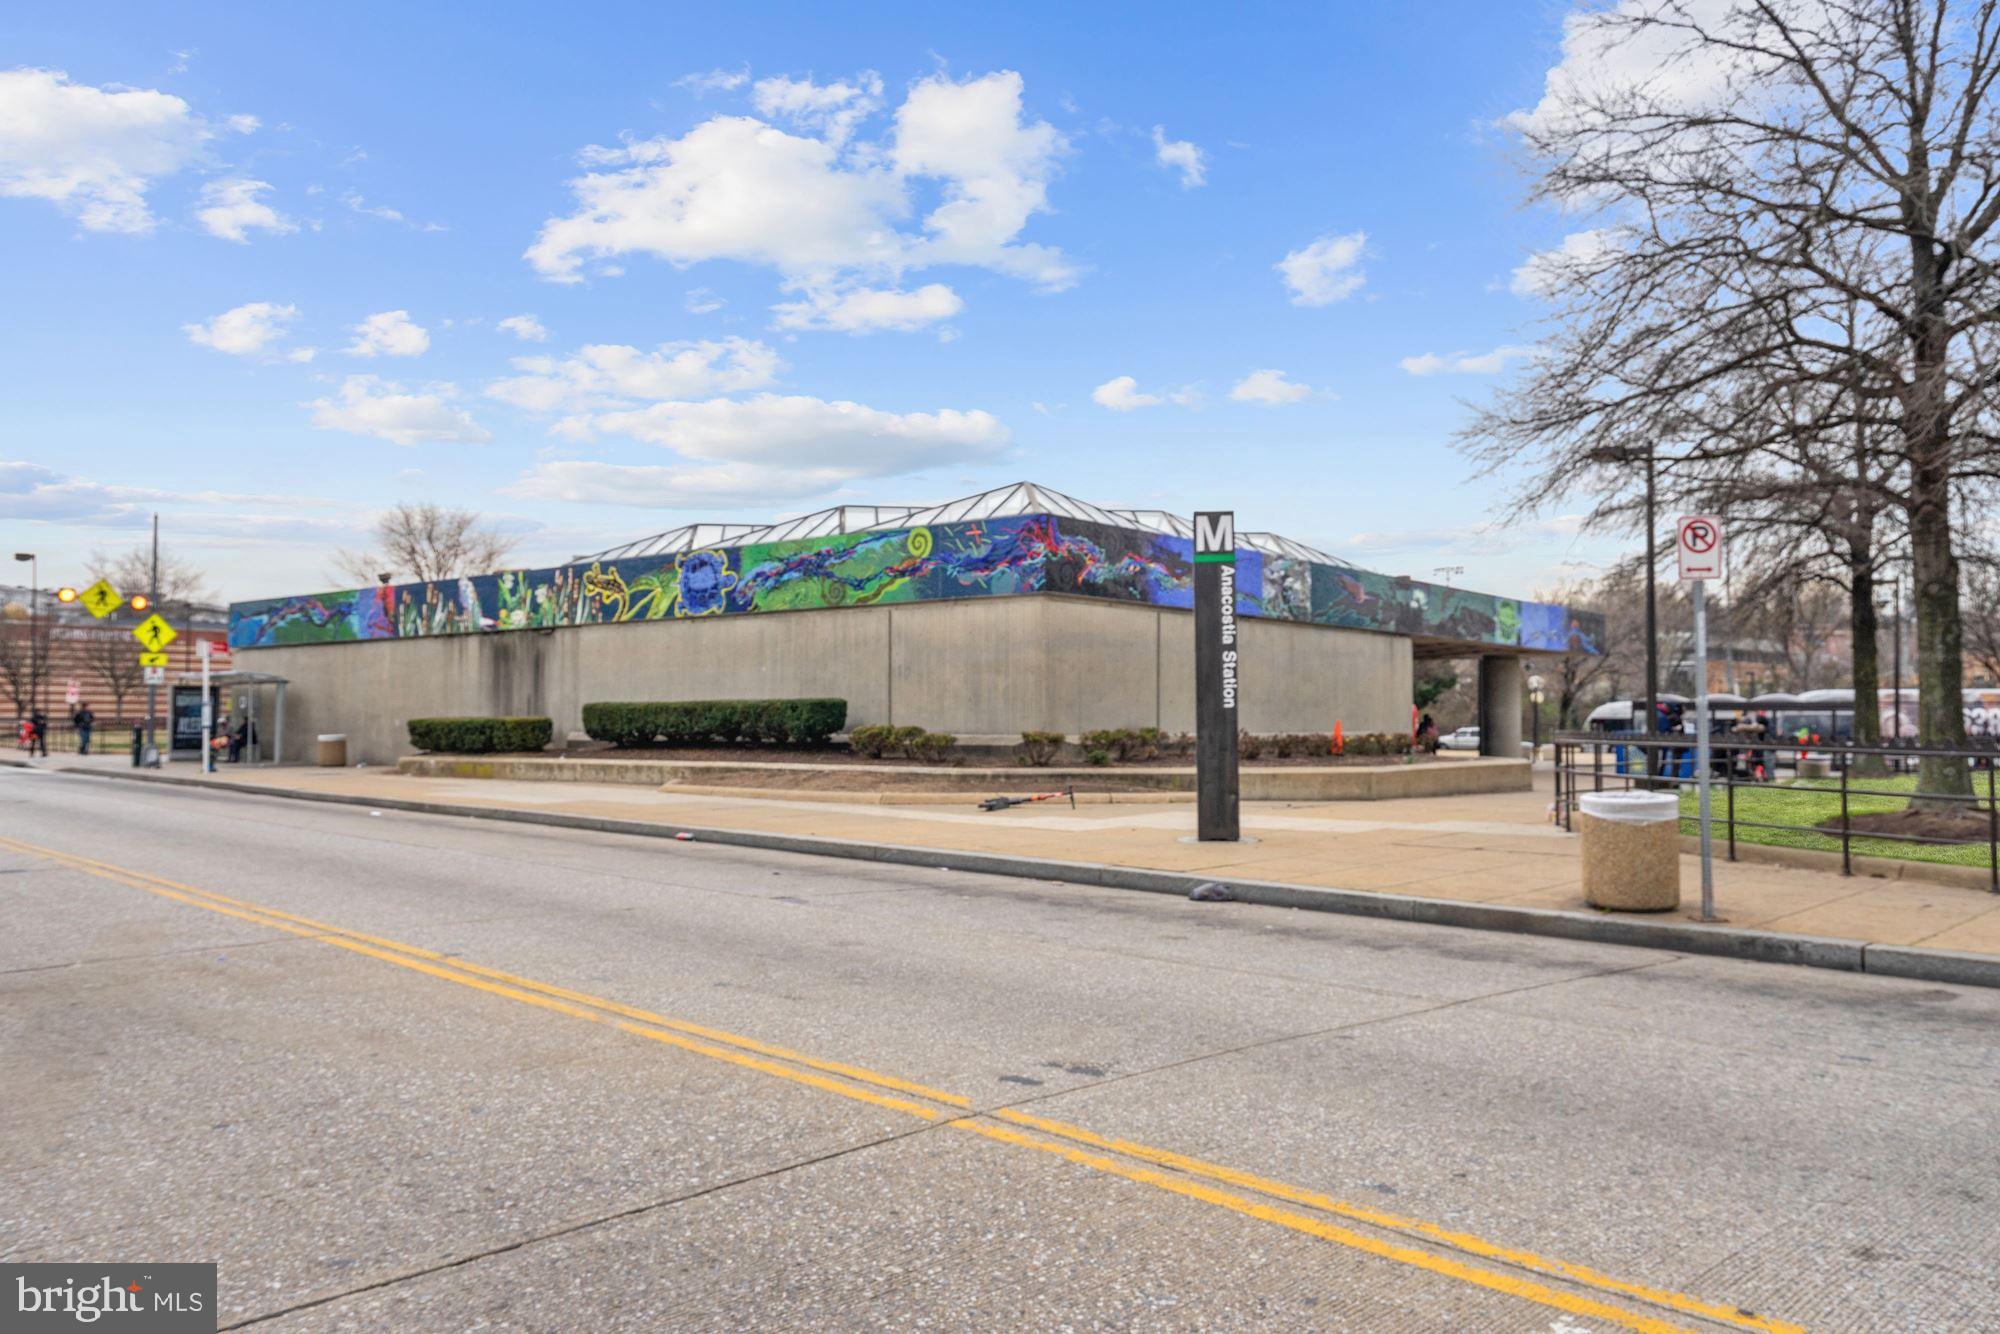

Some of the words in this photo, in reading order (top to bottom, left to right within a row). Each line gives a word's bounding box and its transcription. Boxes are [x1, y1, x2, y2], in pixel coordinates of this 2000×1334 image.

[1196, 515, 1233, 552] M
[1221, 565, 1236, 645] Anacostia
[1222, 650, 1238, 709] Station
